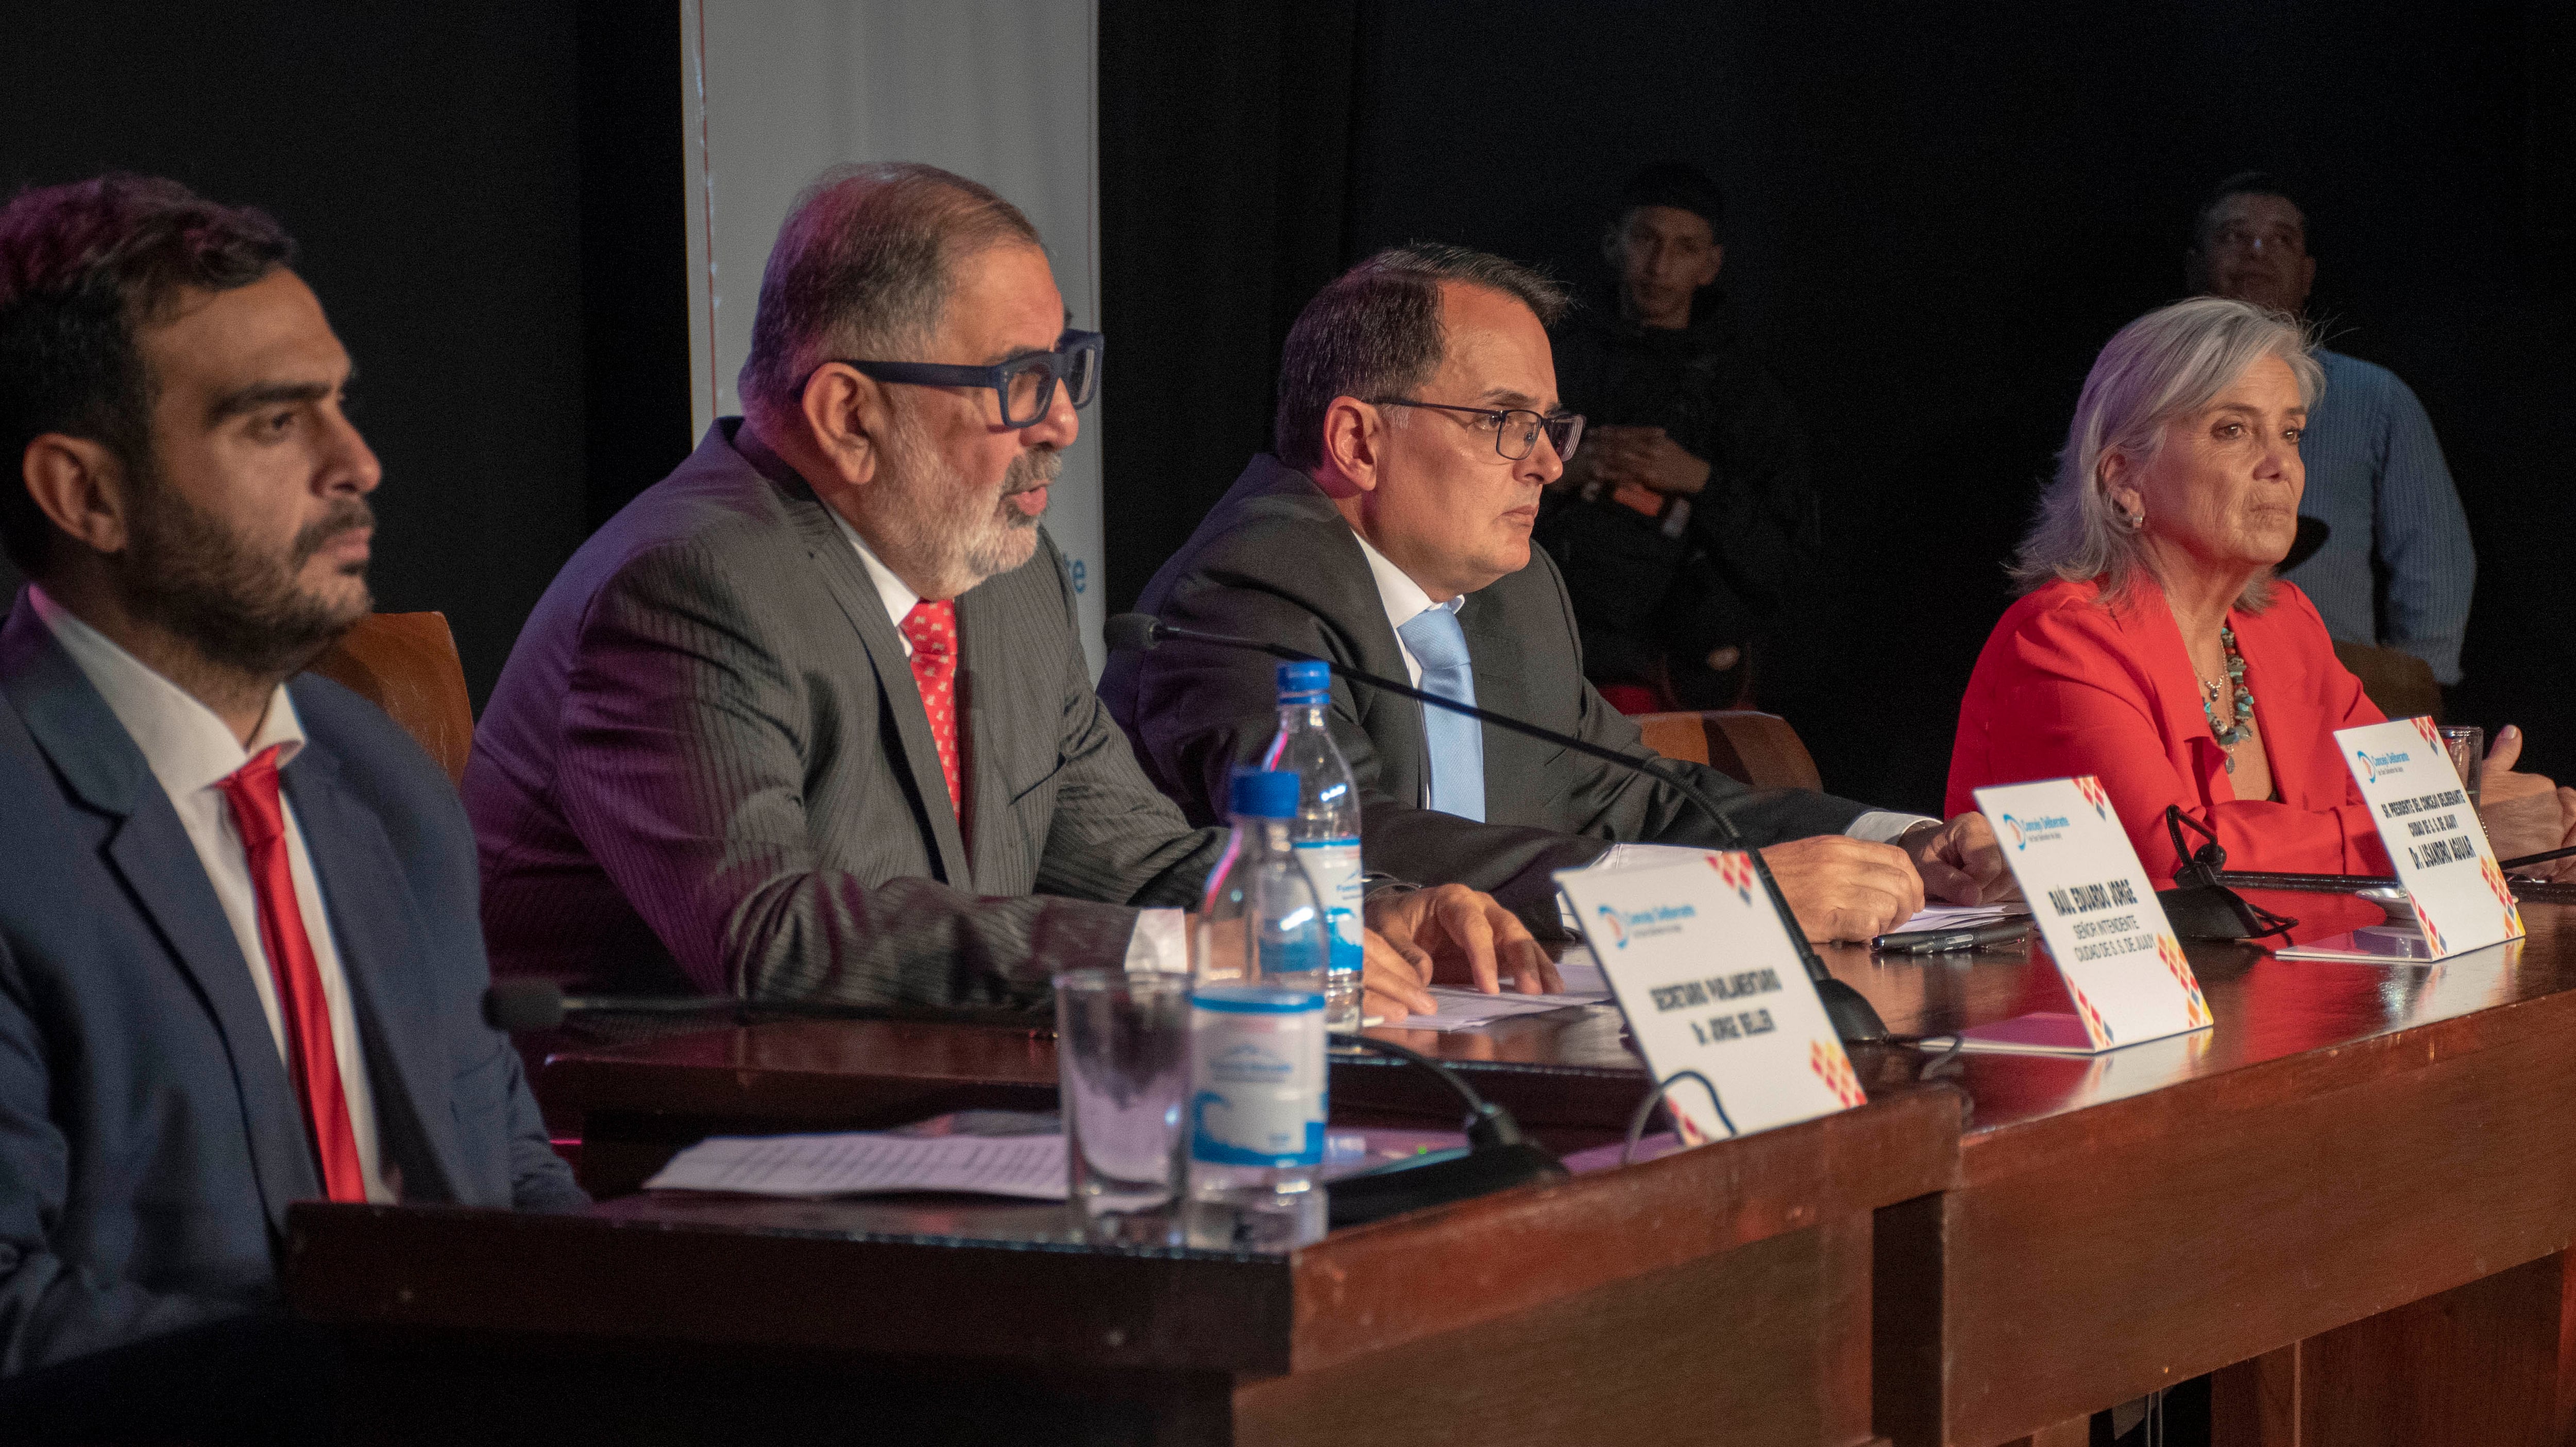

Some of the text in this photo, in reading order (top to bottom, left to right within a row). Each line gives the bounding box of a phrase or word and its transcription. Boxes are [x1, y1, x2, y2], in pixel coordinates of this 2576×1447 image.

[2388, 799, 2415, 818] PRESIDENTE
[2411, 797, 2424, 813] DEL
[2419, 794, 2441, 811] CONCEJO
[2437, 789, 2466, 807] DELIBERANTE
[2408, 820, 2425, 837] CIUDAD
[2421, 819, 2431, 835] DE
[2436, 816, 2447, 831] DE
[2443, 814, 2459, 830] JUJUY
[2408, 835, 2477, 870] Dr. LISANDRO AGUIAR
[2048, 879, 2139, 917] RAÚL EDUARDO JORGE
[2073, 915, 2140, 940] SEÑOR INTENDENTE
[2074, 944, 2102, 962] CIUDAD
[2099, 942, 2112, 958] DE
[2124, 937, 2137, 952] DE
[2135, 932, 2157, 951] JUJUY
